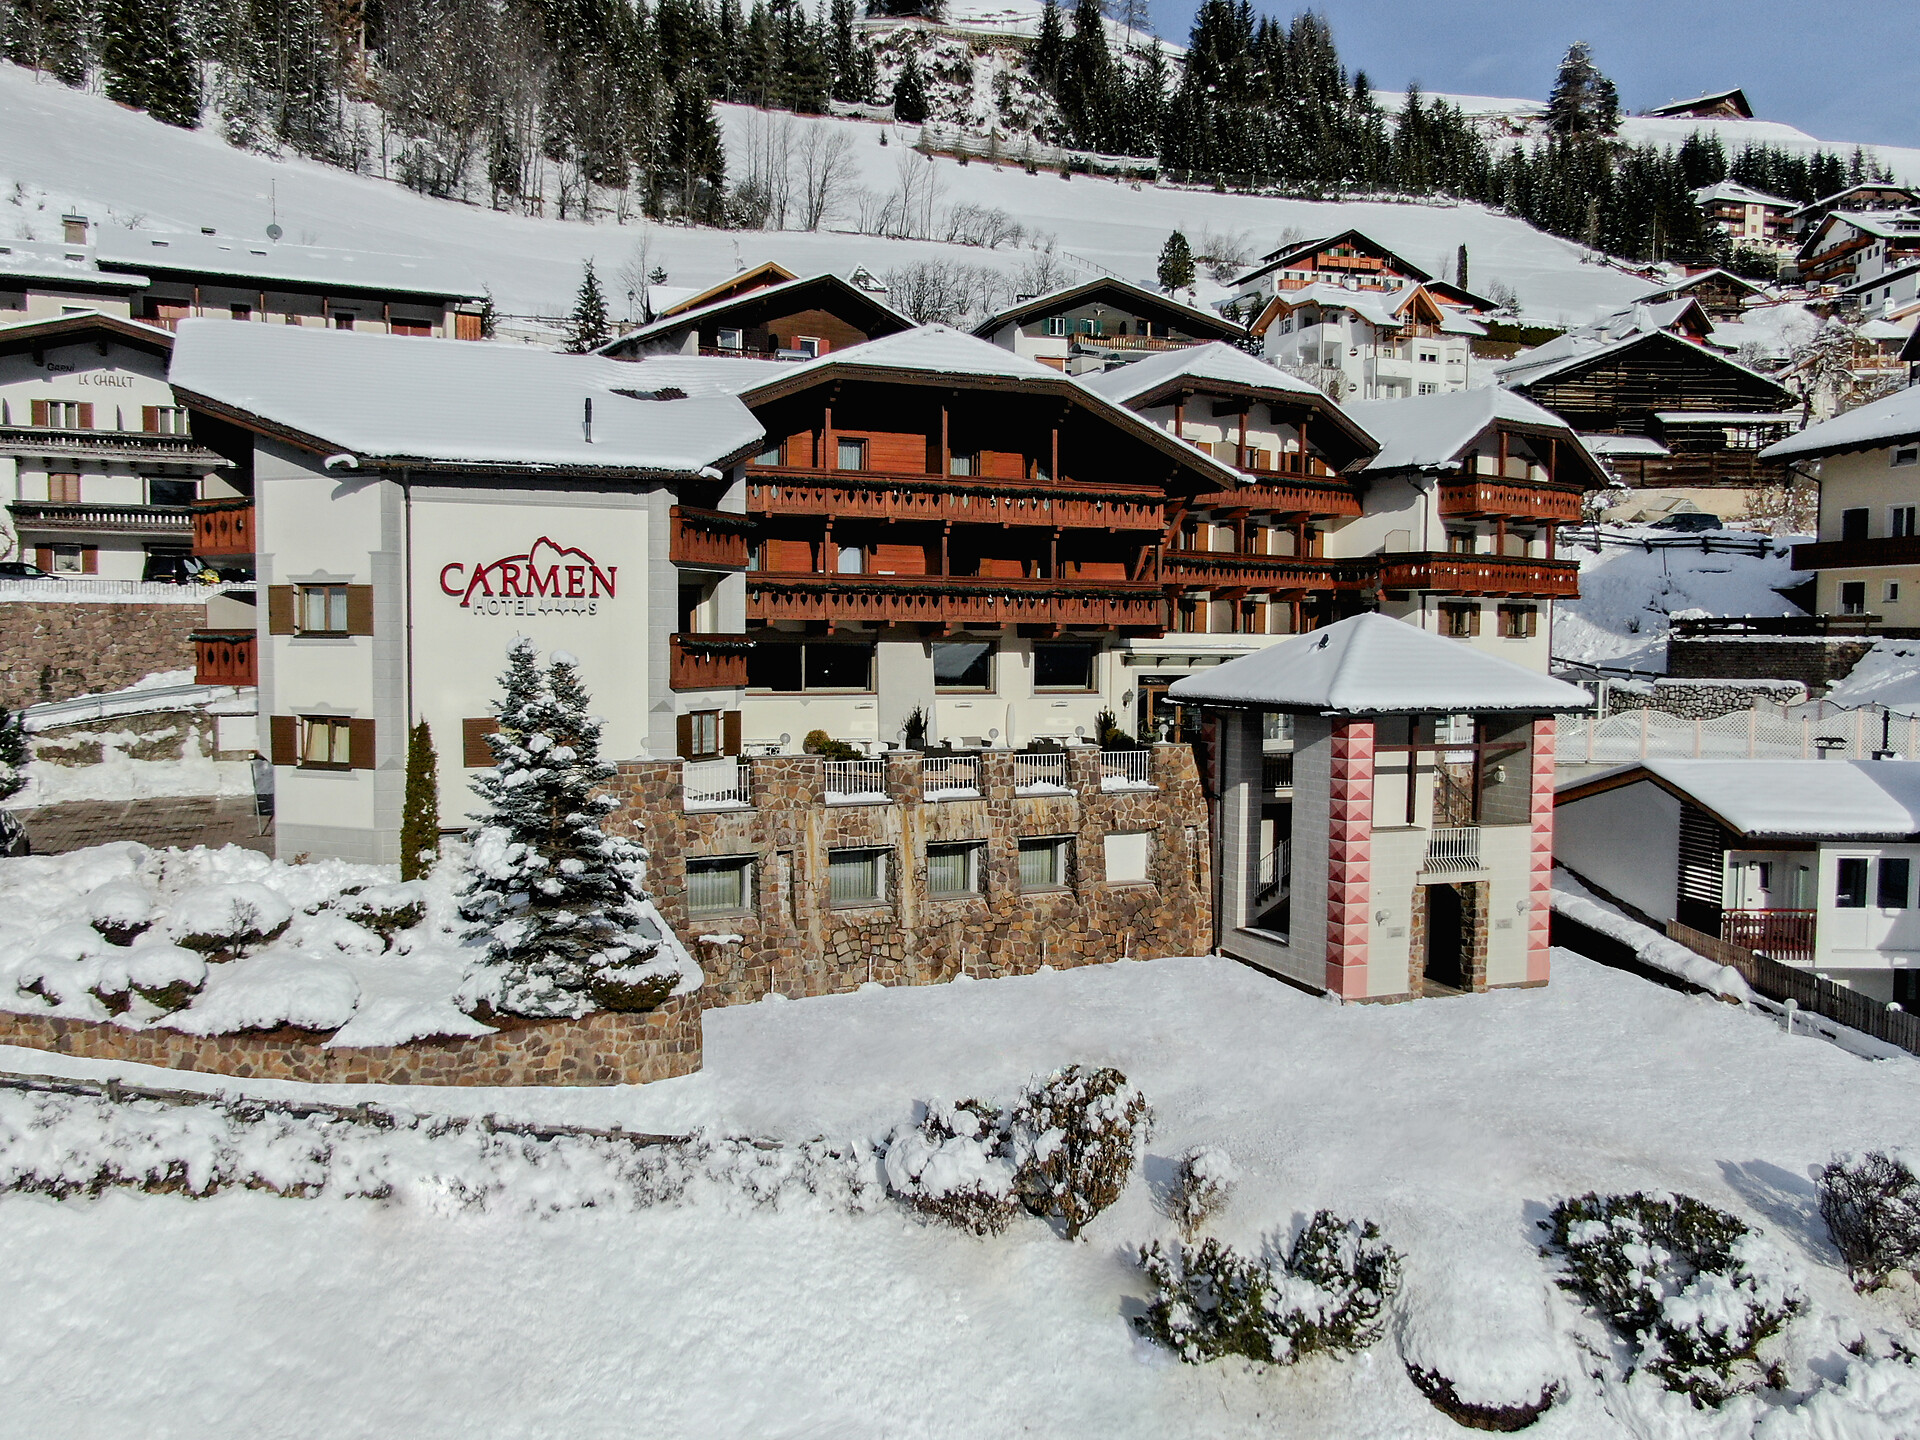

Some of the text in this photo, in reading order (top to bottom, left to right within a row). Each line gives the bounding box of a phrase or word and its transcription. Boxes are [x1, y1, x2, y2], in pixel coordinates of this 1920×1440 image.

[78, 374, 135, 388] LE CHALET
[440, 562, 618, 607] CARMEN
[473, 598, 536, 616] HOTEL
